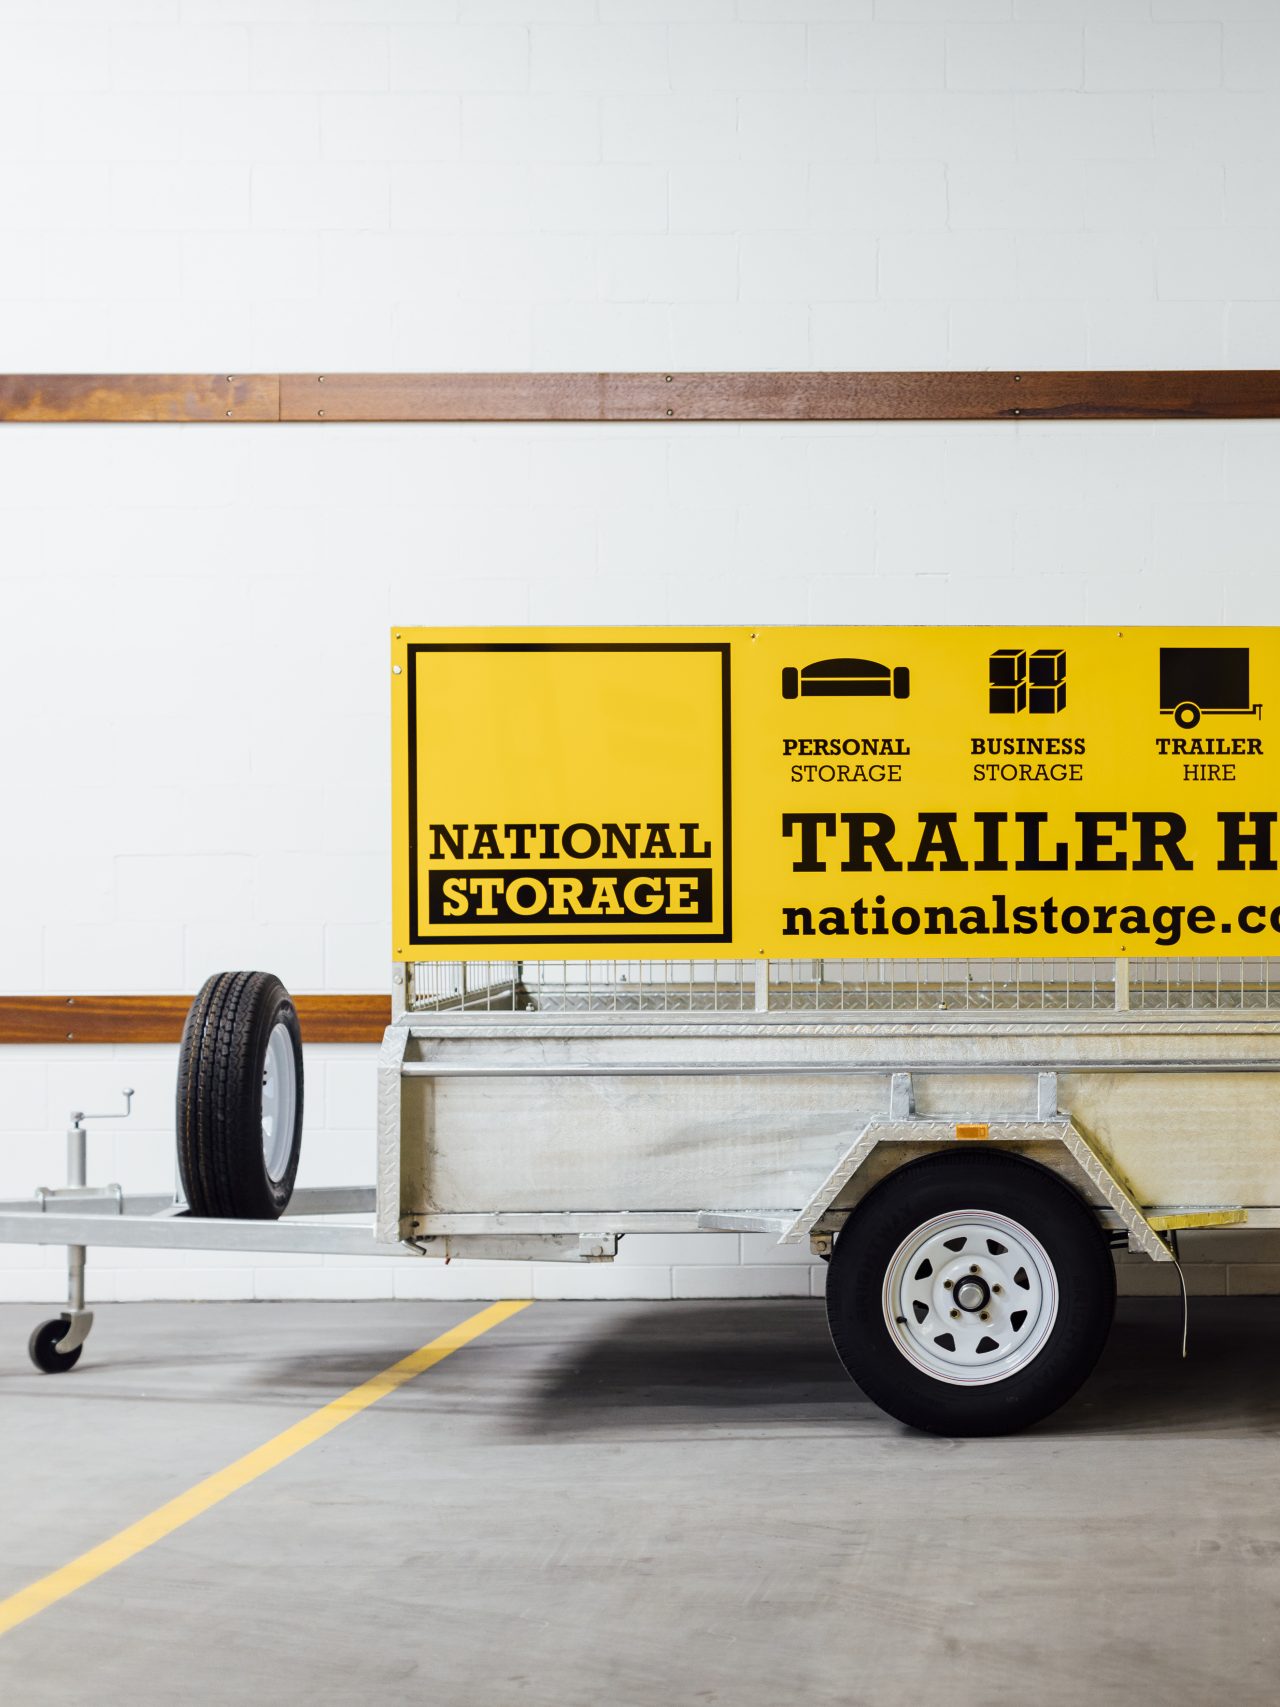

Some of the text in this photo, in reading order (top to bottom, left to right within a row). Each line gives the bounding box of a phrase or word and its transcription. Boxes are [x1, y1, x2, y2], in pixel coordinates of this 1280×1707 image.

[783, 739, 911, 756] PERSONAL
[970, 738, 1086, 755] BUSINESS
[1156, 738, 1264, 755] TRAILER
[791, 764, 902, 783] STORAGE
[973, 763, 1083, 782] STORAGE
[1183, 764, 1236, 781] HIRE
[430, 823, 712, 859] NATIONAL
[783, 812, 1193, 872] TRAILER
[442, 877, 700, 917] STORAGE
